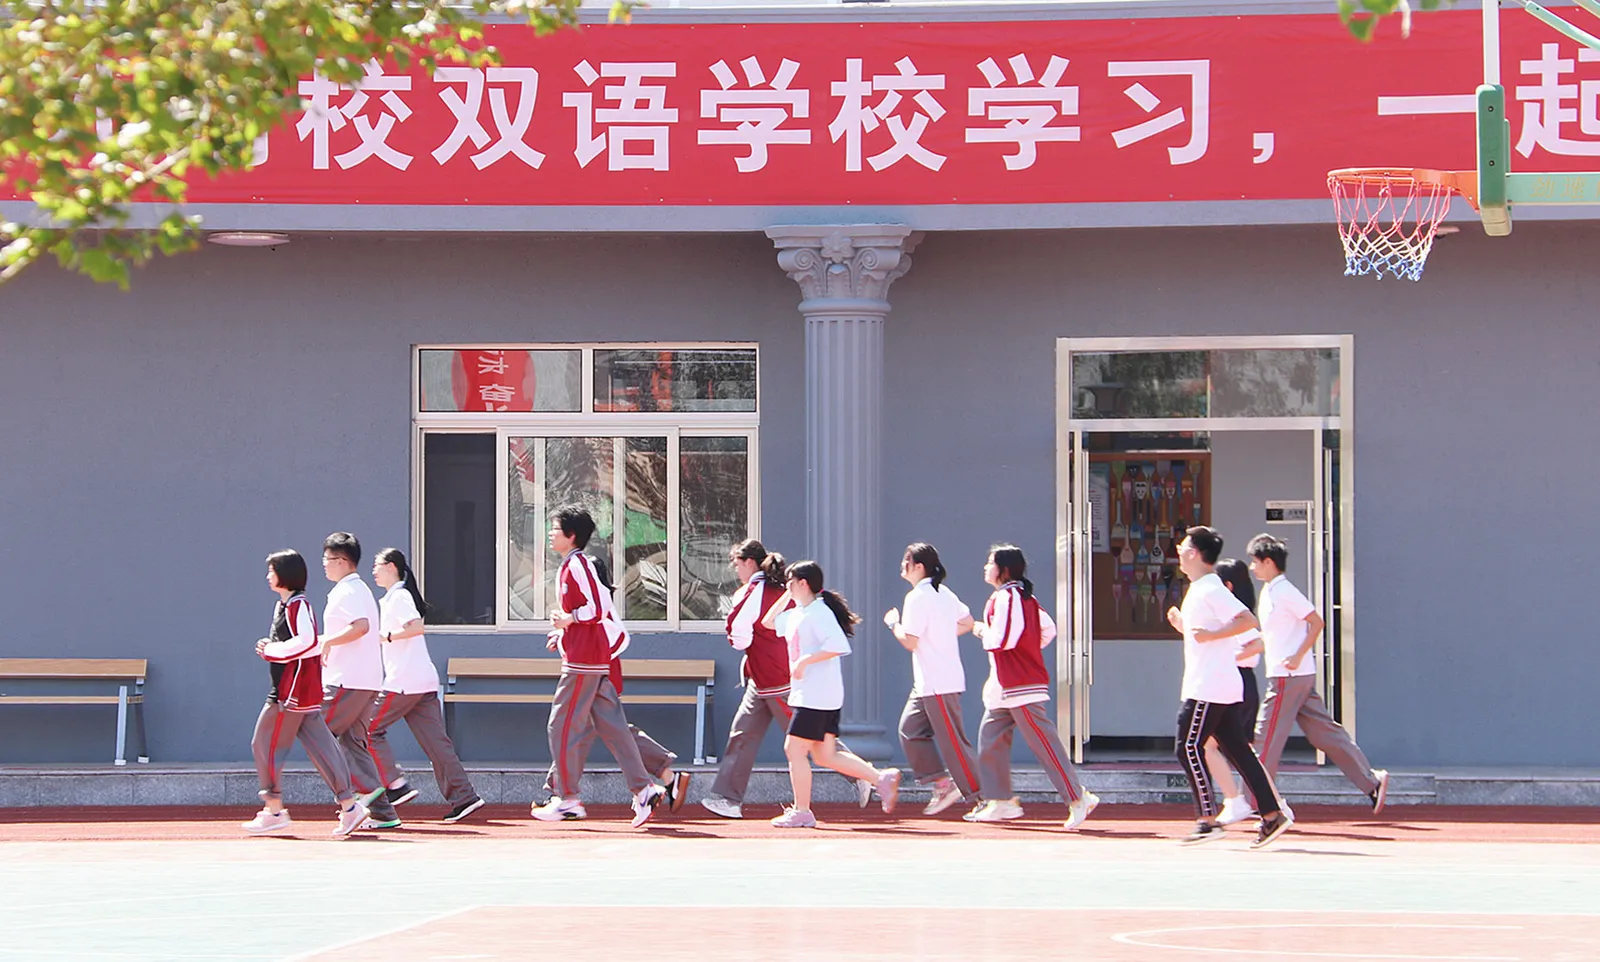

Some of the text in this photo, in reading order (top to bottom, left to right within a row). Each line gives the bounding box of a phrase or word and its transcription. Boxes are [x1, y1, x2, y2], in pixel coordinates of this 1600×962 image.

[95, 43, 1600, 174] 校双语学校学习，一起
